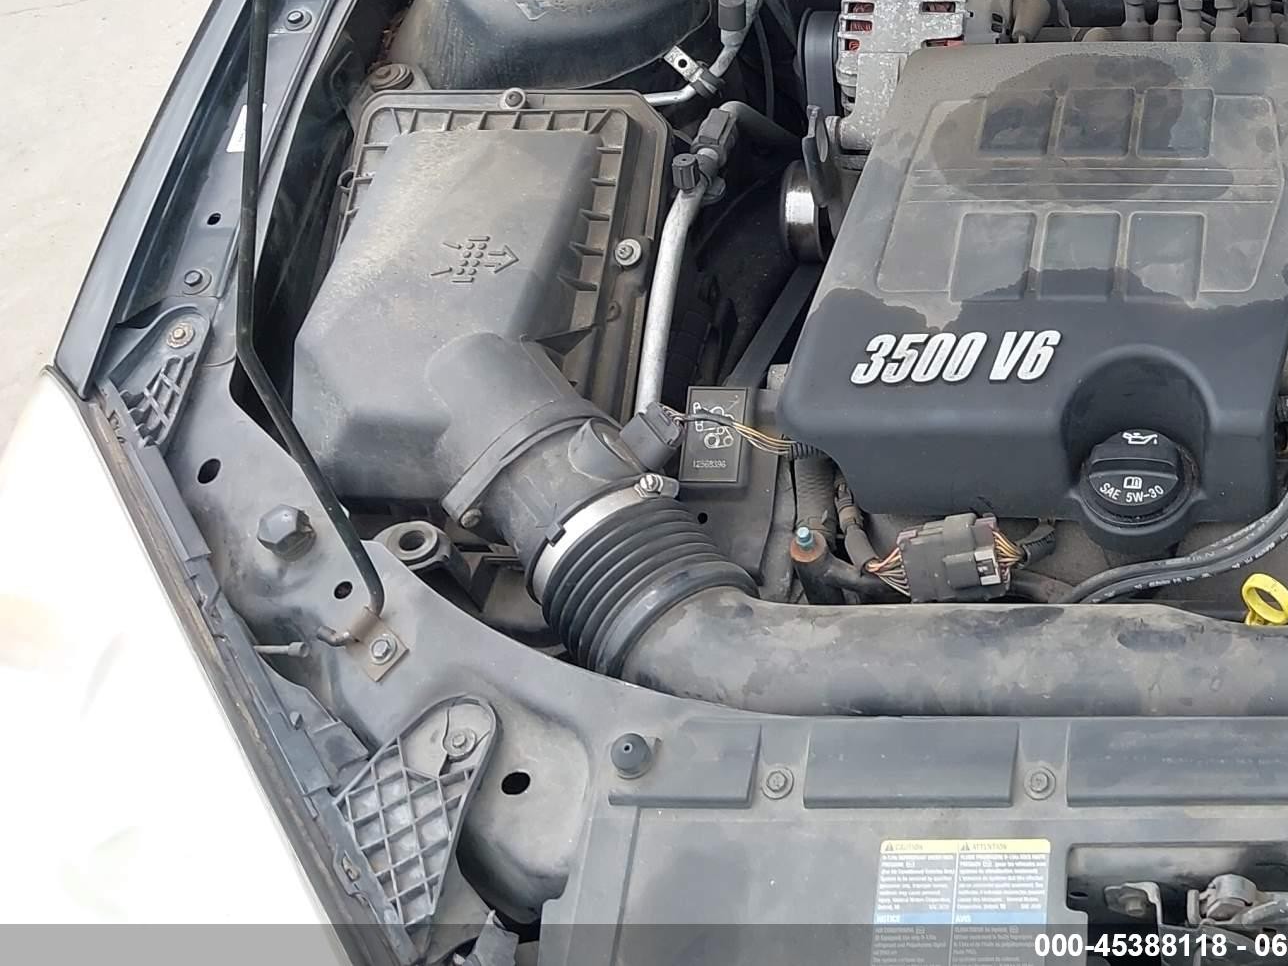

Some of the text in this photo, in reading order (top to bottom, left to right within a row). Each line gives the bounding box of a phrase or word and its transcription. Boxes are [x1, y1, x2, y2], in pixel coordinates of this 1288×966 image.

[850, 330, 1061, 386] 3500 V6
[1099, 482, 1164, 503] SAE 5W-30
[895, 842, 924, 851] CAUTION
[972, 842, 1008, 851] ATTENTION
